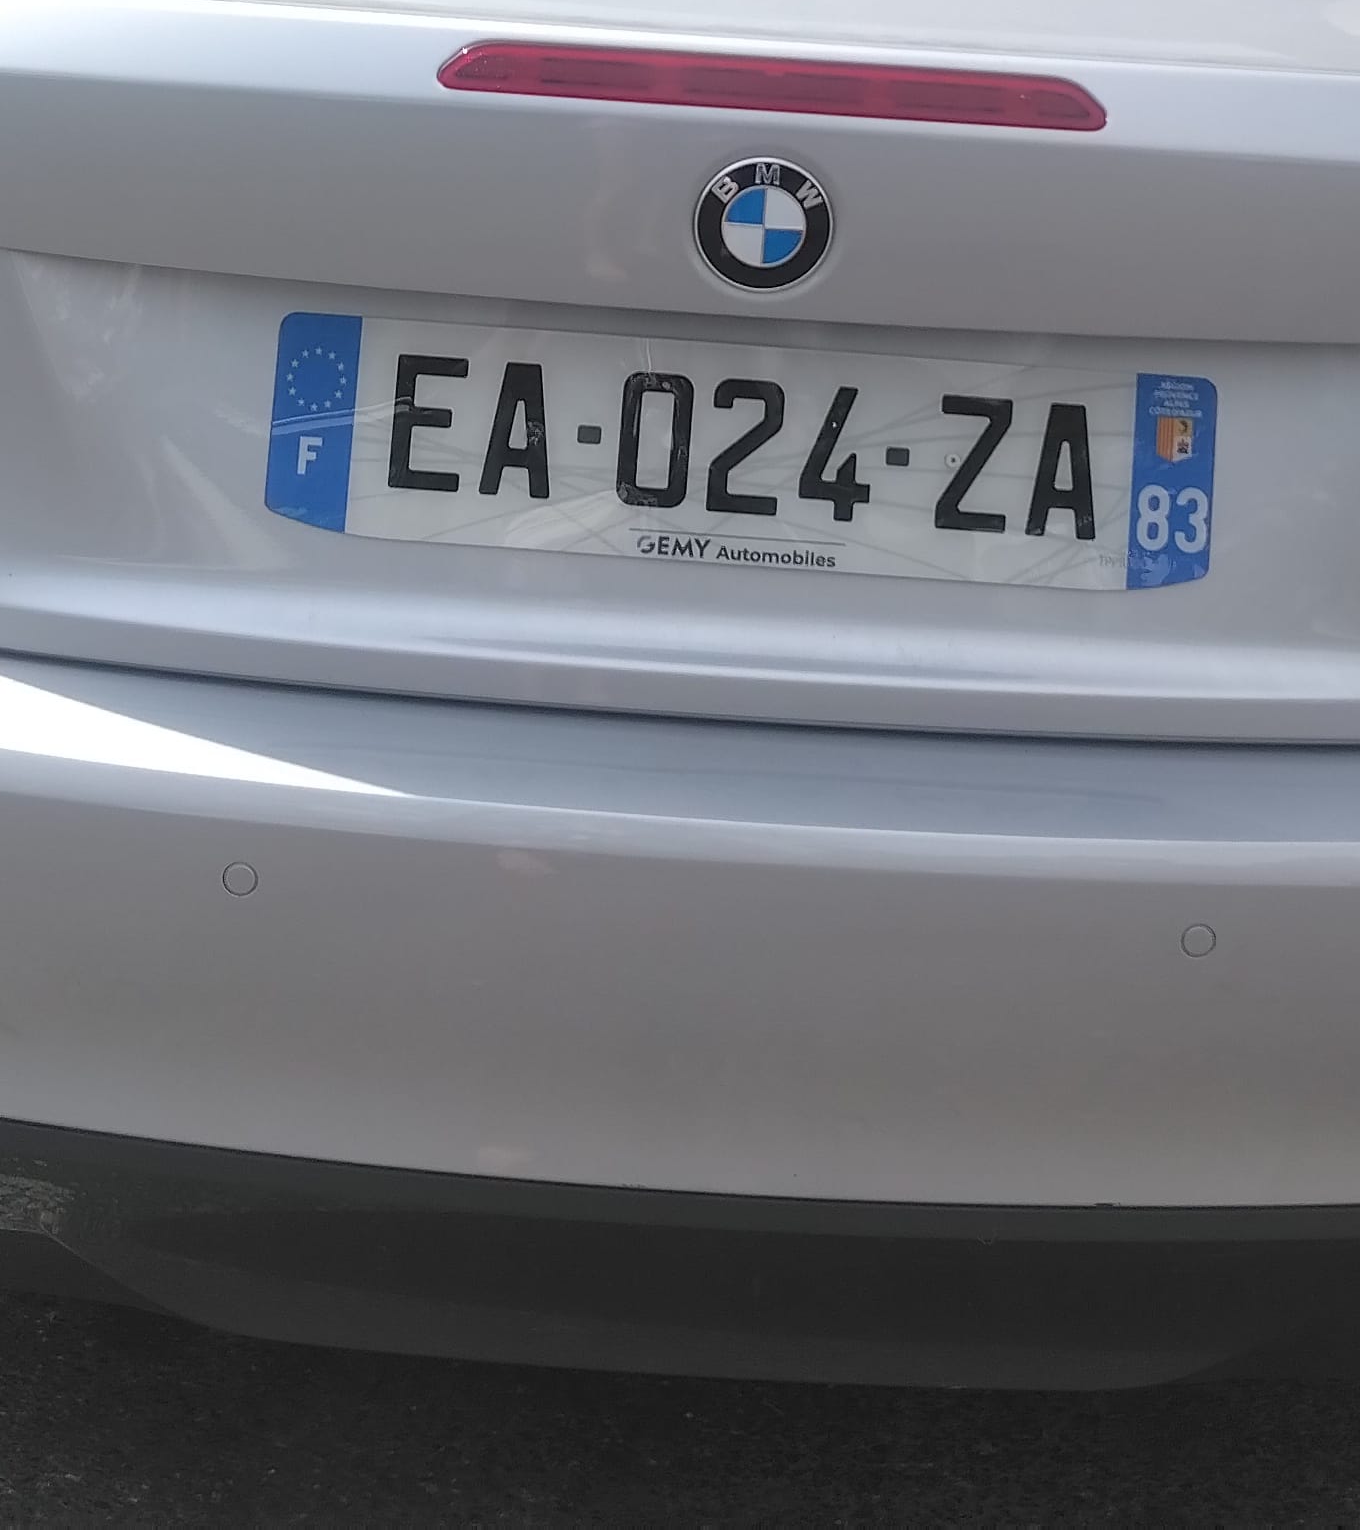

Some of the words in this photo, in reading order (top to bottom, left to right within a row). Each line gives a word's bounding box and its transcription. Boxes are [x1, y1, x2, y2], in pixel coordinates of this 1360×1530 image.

[711, 163, 824, 210] BMW
[297, 436, 323, 475] F
[387, 353, 1097, 543] EA-024-ZA
[1136, 484, 1209, 554] 83
[637, 534, 711, 559] GEMY
[716, 545, 837, 568] Automobiles
